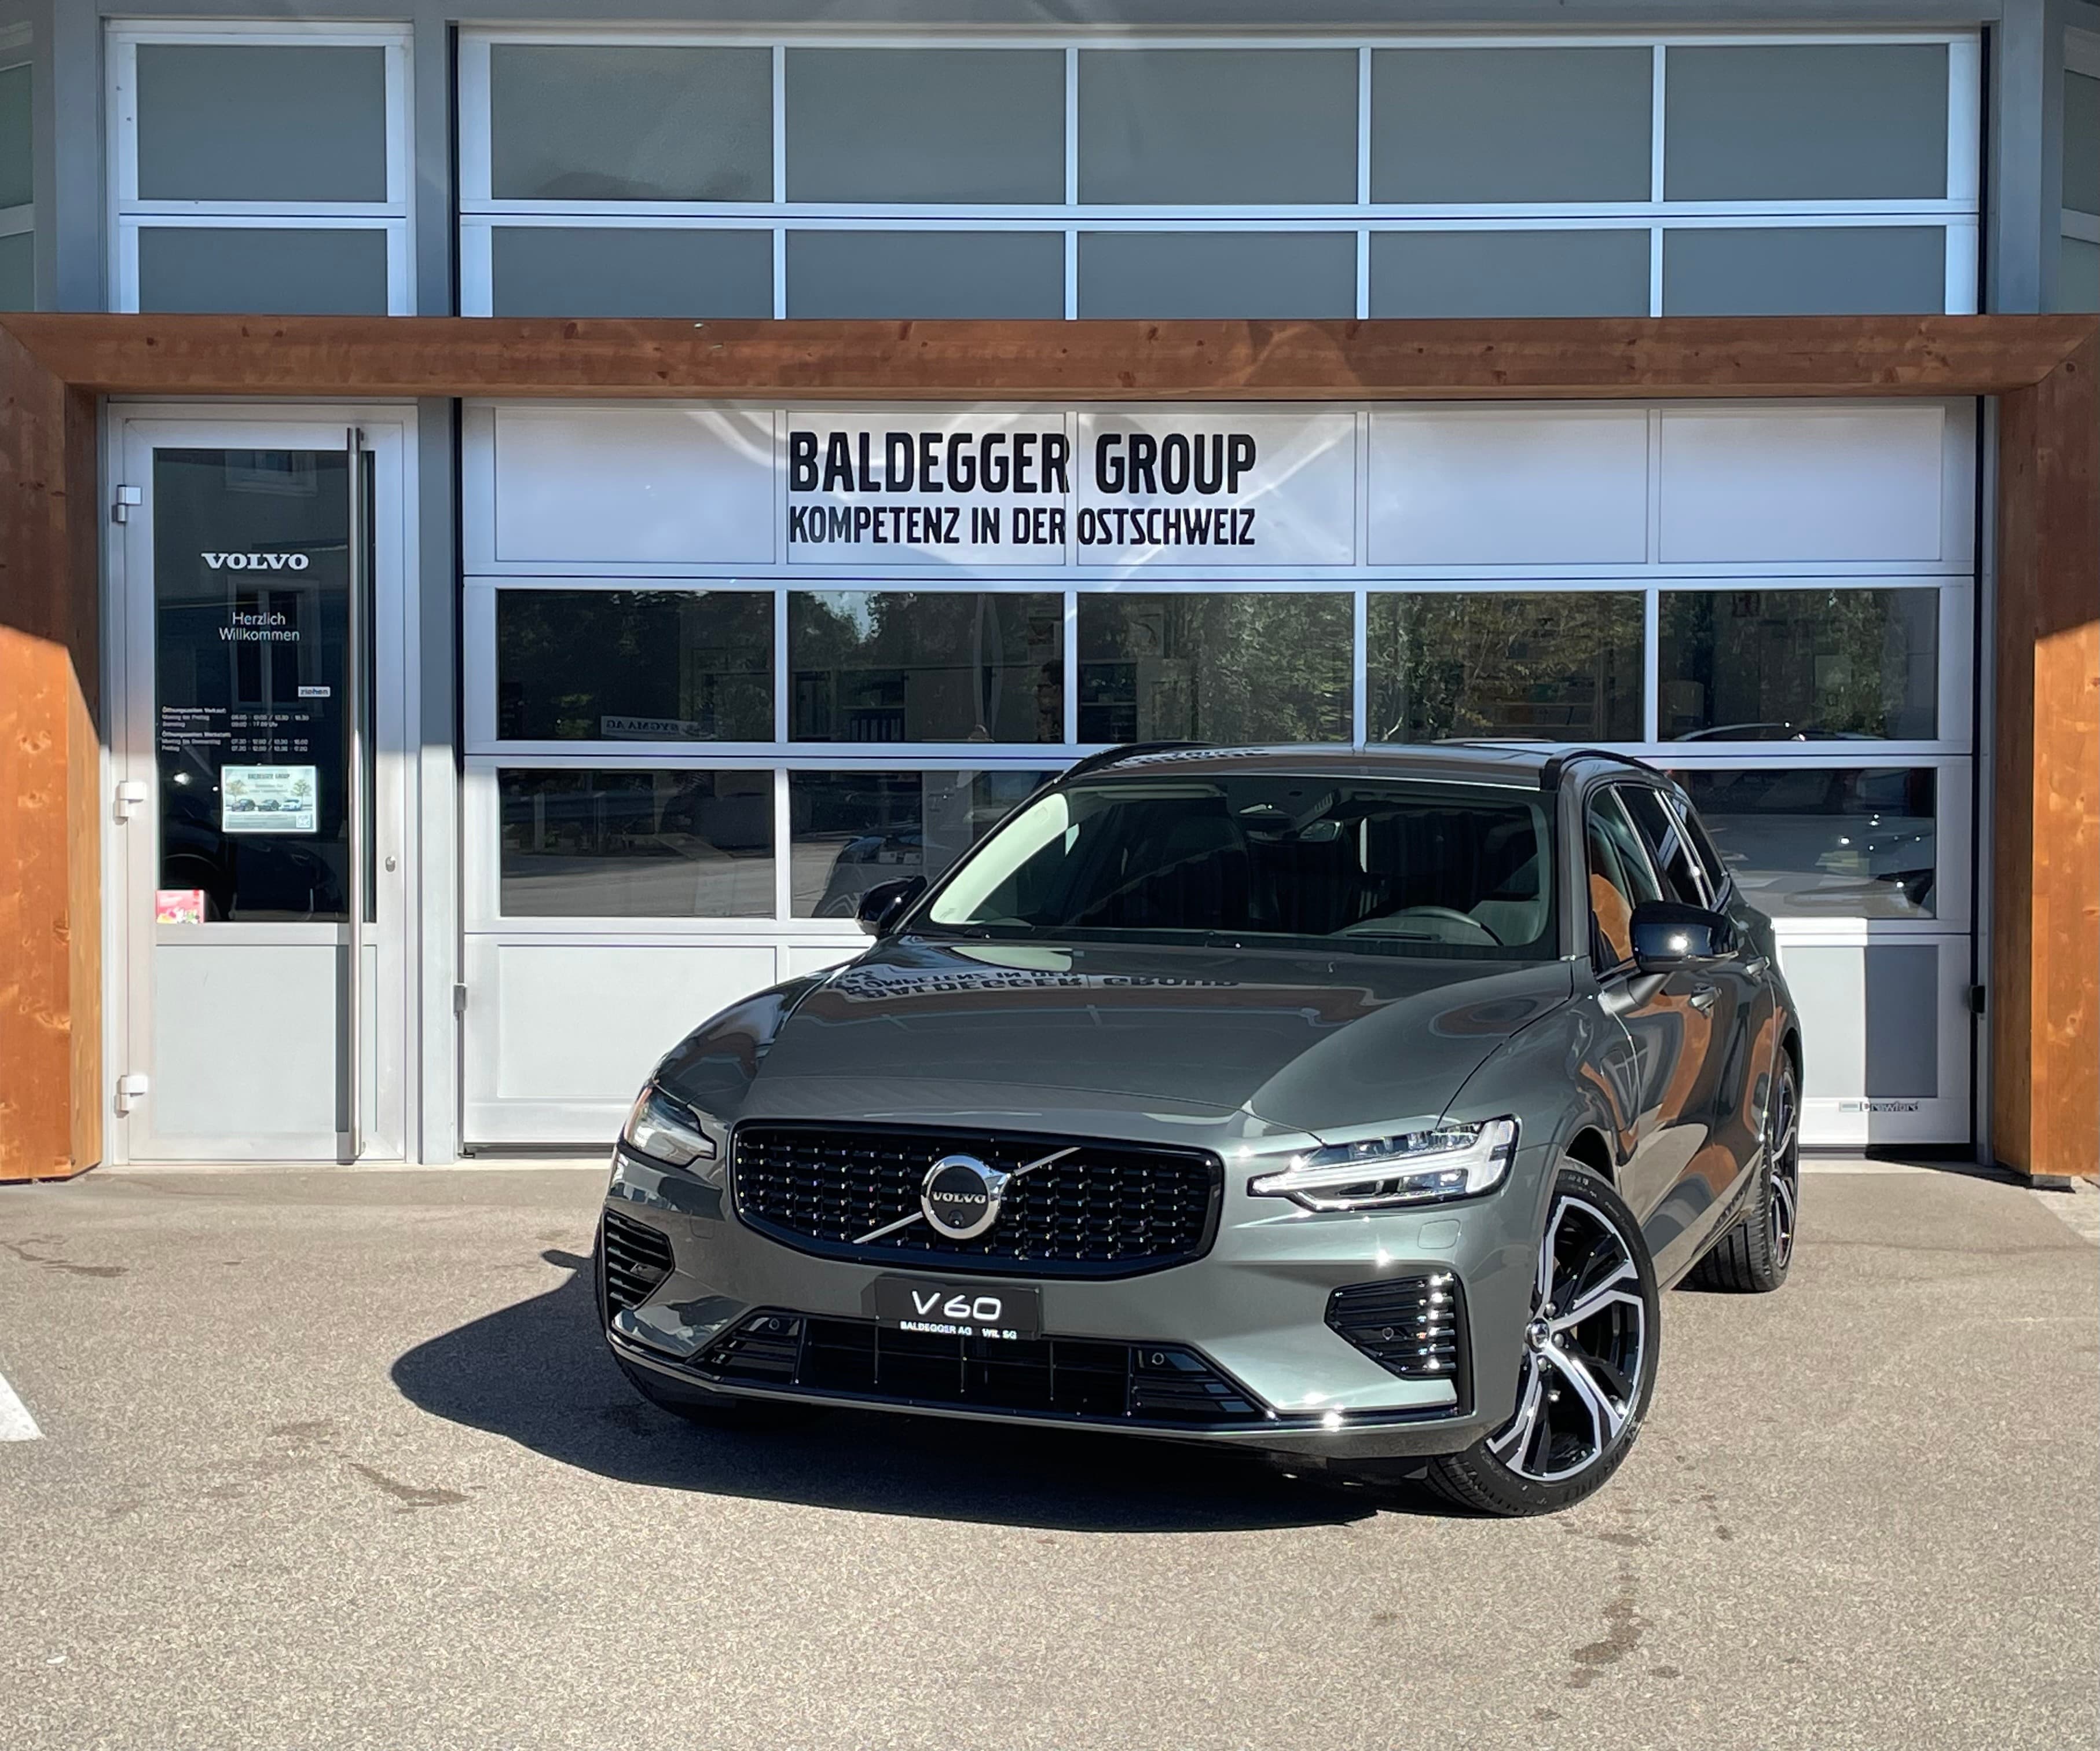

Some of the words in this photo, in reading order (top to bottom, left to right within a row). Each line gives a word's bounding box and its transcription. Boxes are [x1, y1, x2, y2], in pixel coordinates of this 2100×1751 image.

[789, 431, 1070, 493] BALDEGGER
[1095, 433, 1256, 495] GROUP
[790, 505, 960, 544] KOMPETENZ
[972, 507, 1000, 544] IN
[1012, 507, 1065, 545] DER
[1078, 507, 1255, 546] OSTSCHWEIZ
[201, 553, 309, 570] VOLVO
[232, 612, 285, 625] Herzlich
[219, 628, 300, 641] Willkommen
[932, 1191, 987, 1204] VOLVO
[911, 1290, 1002, 1321] V60
[900, 1321, 956, 1335] BALDEGGER
[958, 1326, 973, 1336] AG
[1002, 1330, 1017, 1340] SG
